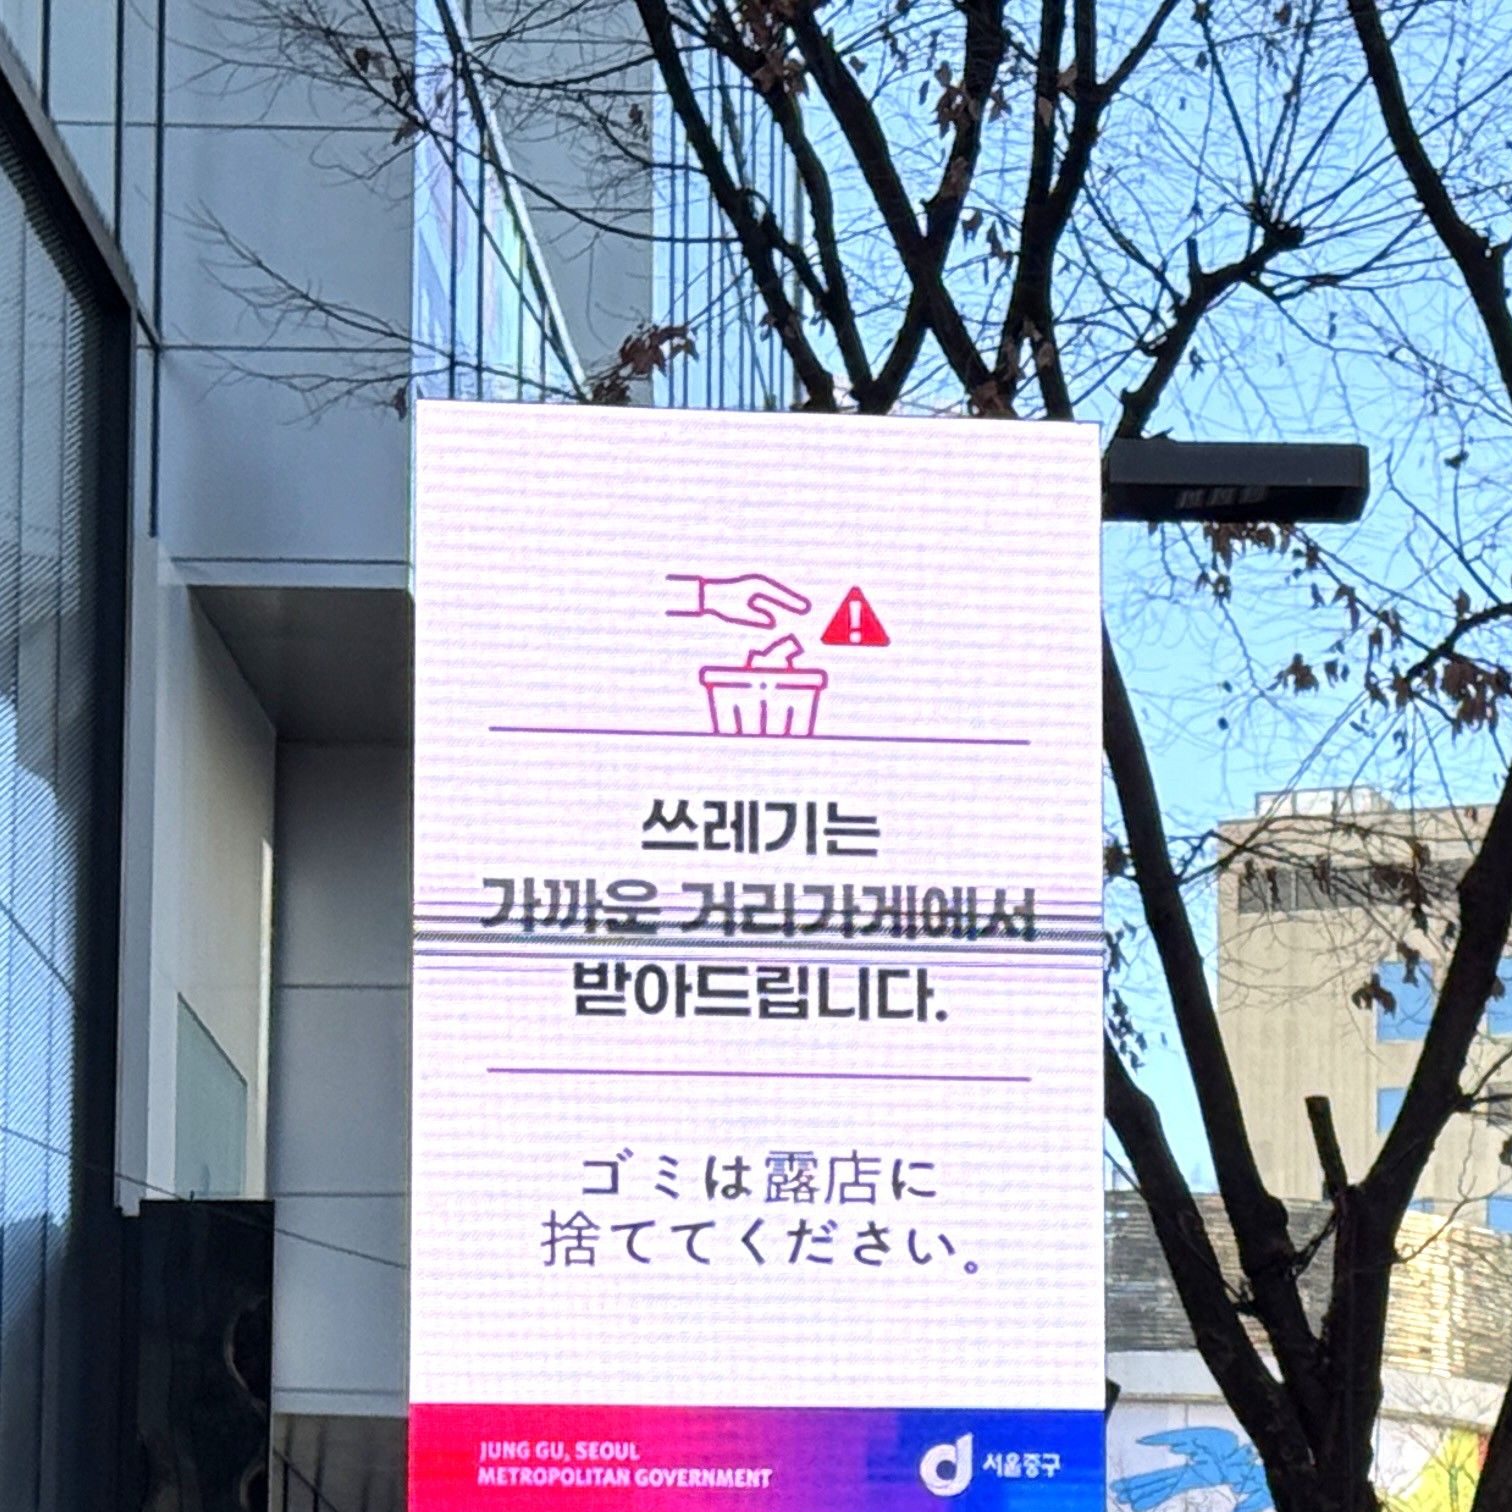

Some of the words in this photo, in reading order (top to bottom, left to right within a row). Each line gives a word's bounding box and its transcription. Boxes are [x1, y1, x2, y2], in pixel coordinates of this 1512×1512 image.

[641, 798, 881, 858] 쓰레기는
[479, 876, 663, 936] 가까운
[681, 879, 1037, 942] 거리가게에서
[573, 961, 949, 1023] 받아드립니다.
[582, 1147, 938, 1206] ゴミは露店に
[540, 1208, 980, 1275] 捨ててください。
[477, 1466, 631, 1488] METROPOLITAN
[633, 1466, 773, 1489] GOVERNMENT
[479, 1440, 529, 1462] JUNG
[534, 1440, 571, 1463] GU,
[574, 1441, 641, 1462] SEOUL
[982, 1451, 1062, 1479] 서울중구
